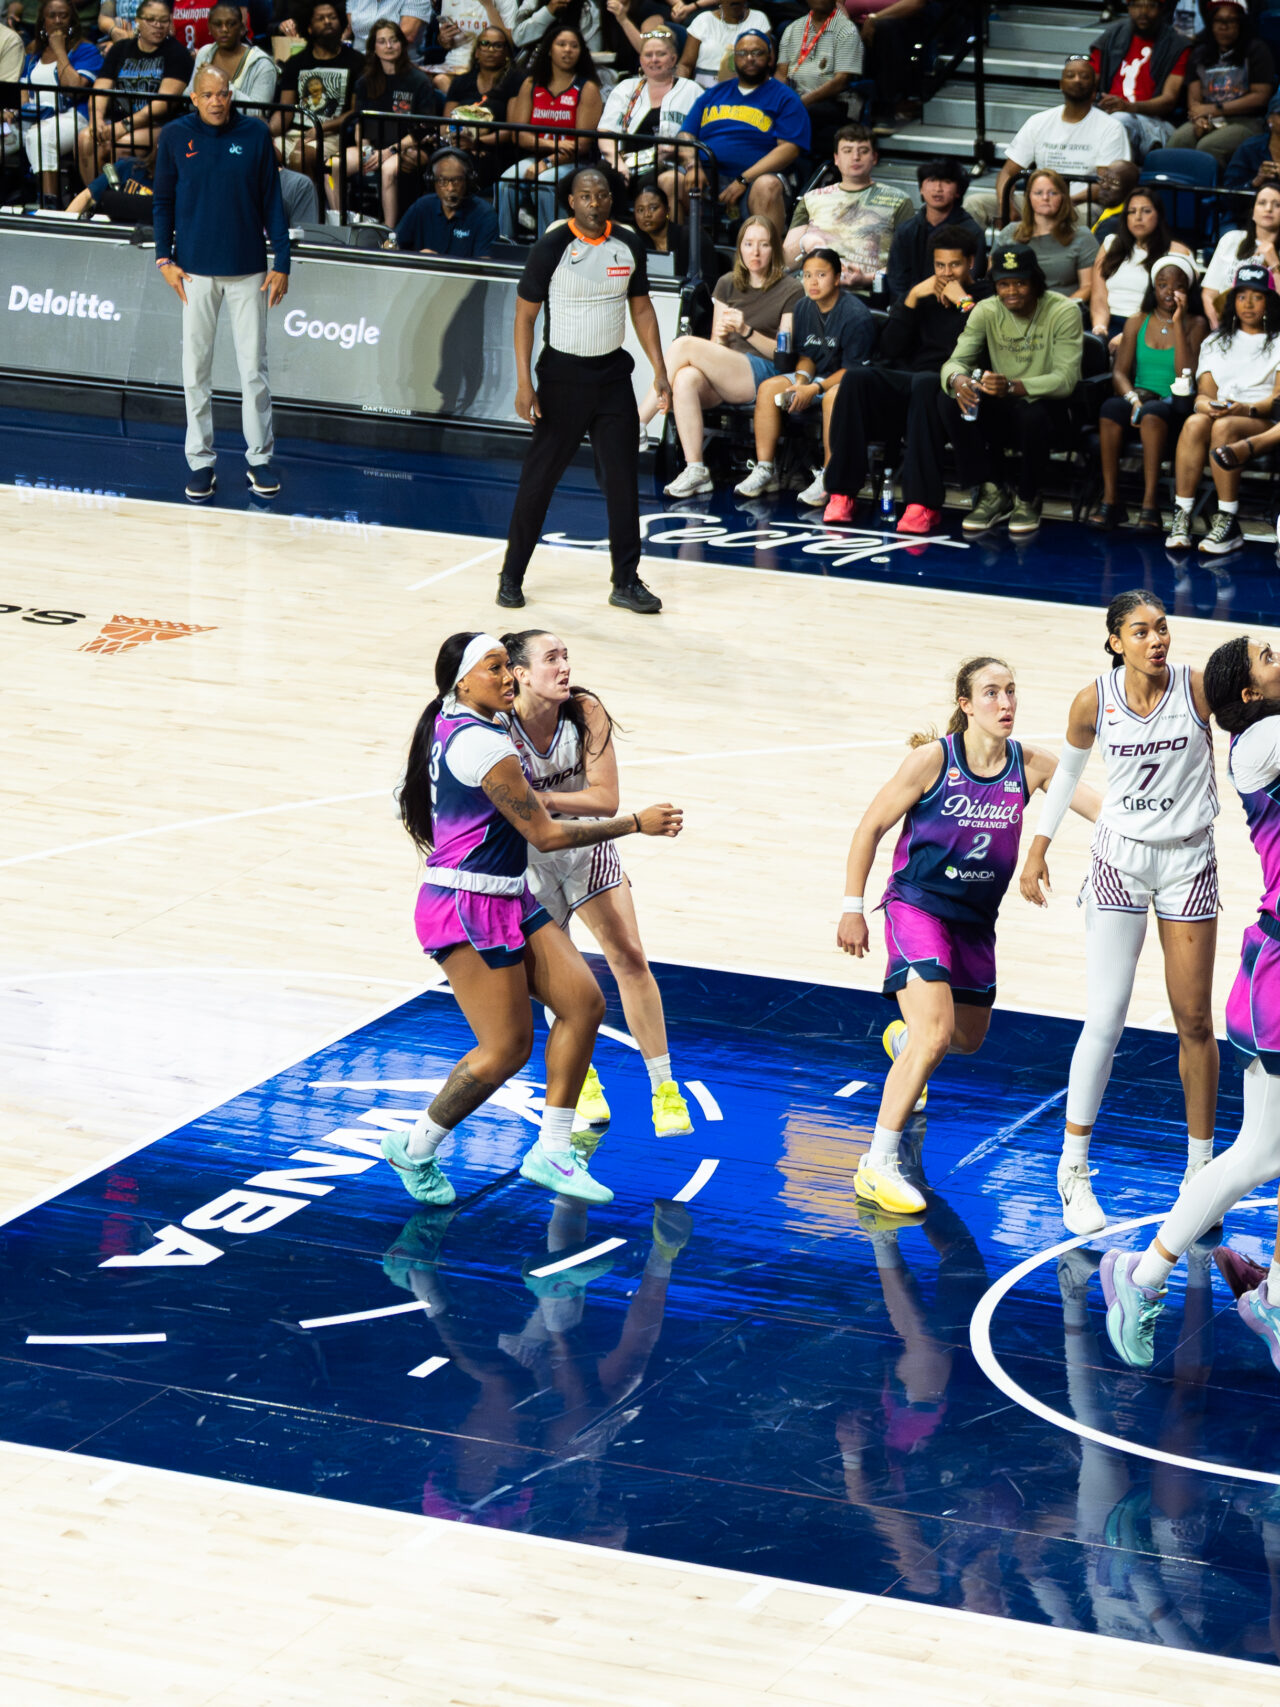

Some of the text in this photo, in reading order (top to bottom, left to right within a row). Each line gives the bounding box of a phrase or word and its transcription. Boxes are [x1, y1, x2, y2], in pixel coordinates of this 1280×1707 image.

[284, 309, 380, 349] Google
[1108, 736, 1188, 757] TEMPO
[531, 761, 584, 791] EMPO
[1138, 763, 1160, 791] 7
[941, 794, 1020, 824] District
[1123, 795, 1158, 812] CIBC
[958, 819, 1008, 829] OF CHANGE
[963, 832, 992, 861] 2
[959, 869, 995, 880] VANDA
[98, 1108, 431, 1267] WNBA
